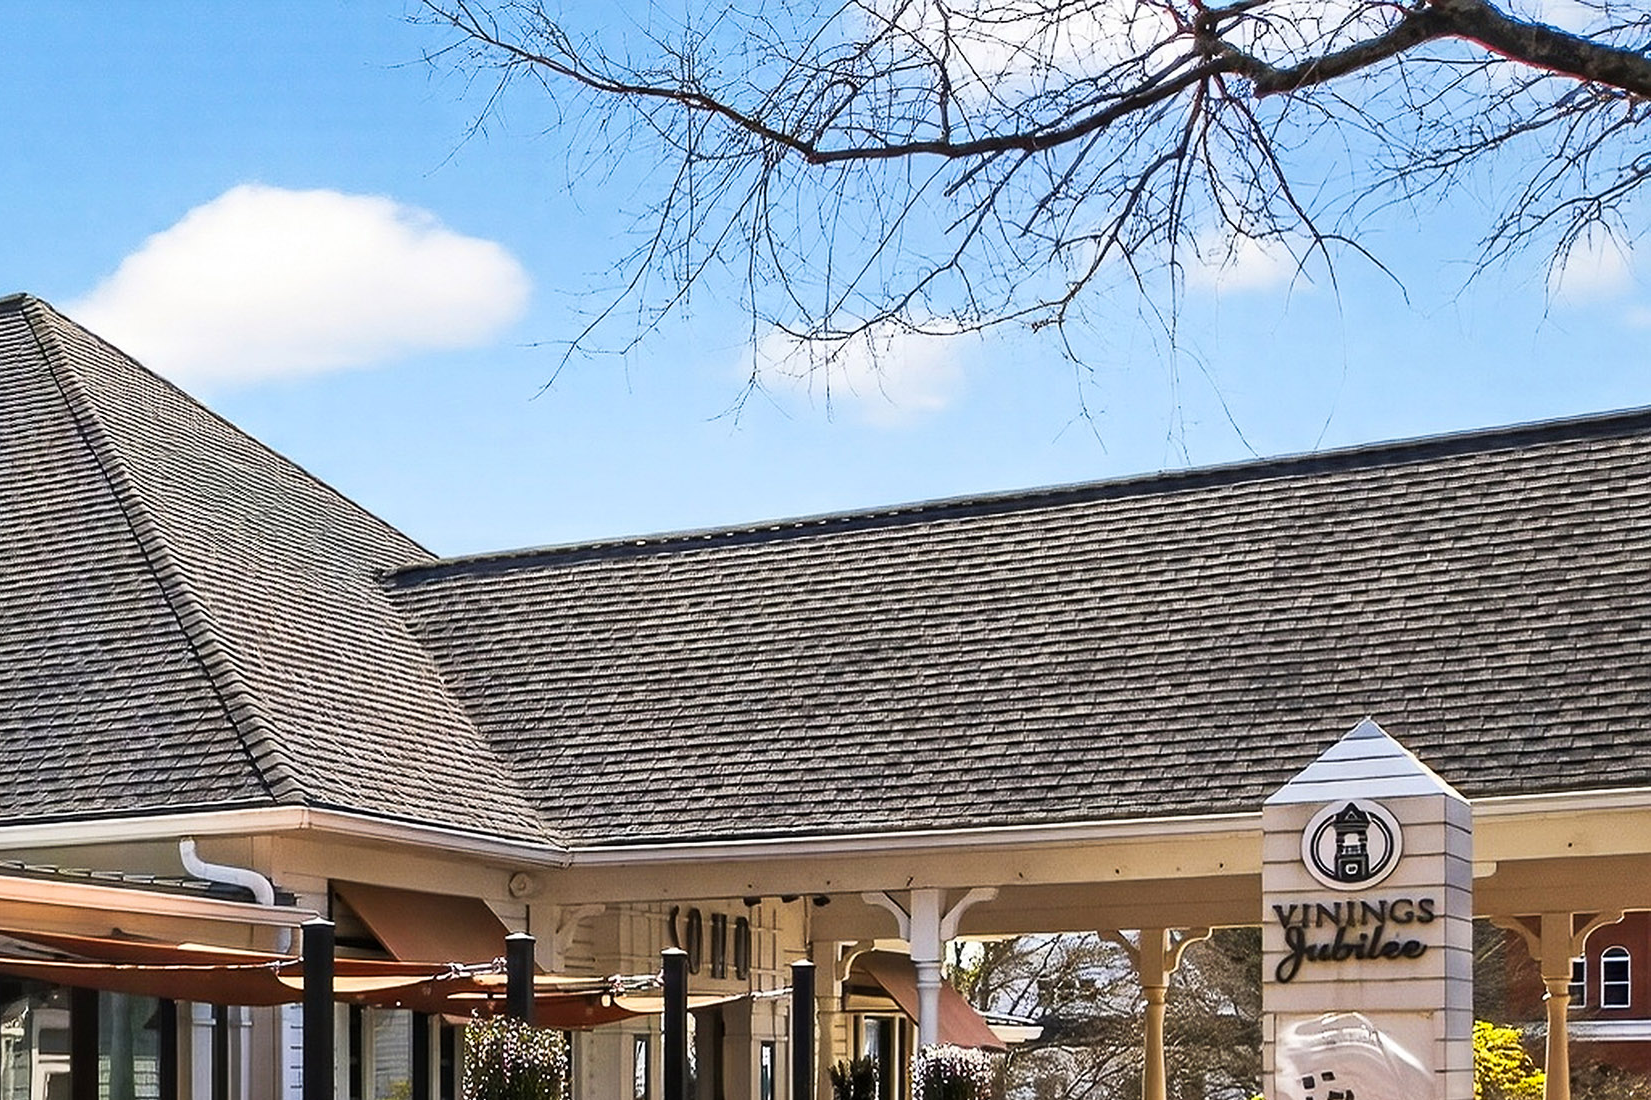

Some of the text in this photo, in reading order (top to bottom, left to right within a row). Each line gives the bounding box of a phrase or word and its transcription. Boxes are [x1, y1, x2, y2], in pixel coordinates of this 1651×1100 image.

[669, 905, 751, 980] SOHO
[1272, 898, 1435, 929] VININGS
[1275, 925, 1427, 983] Jubilee
